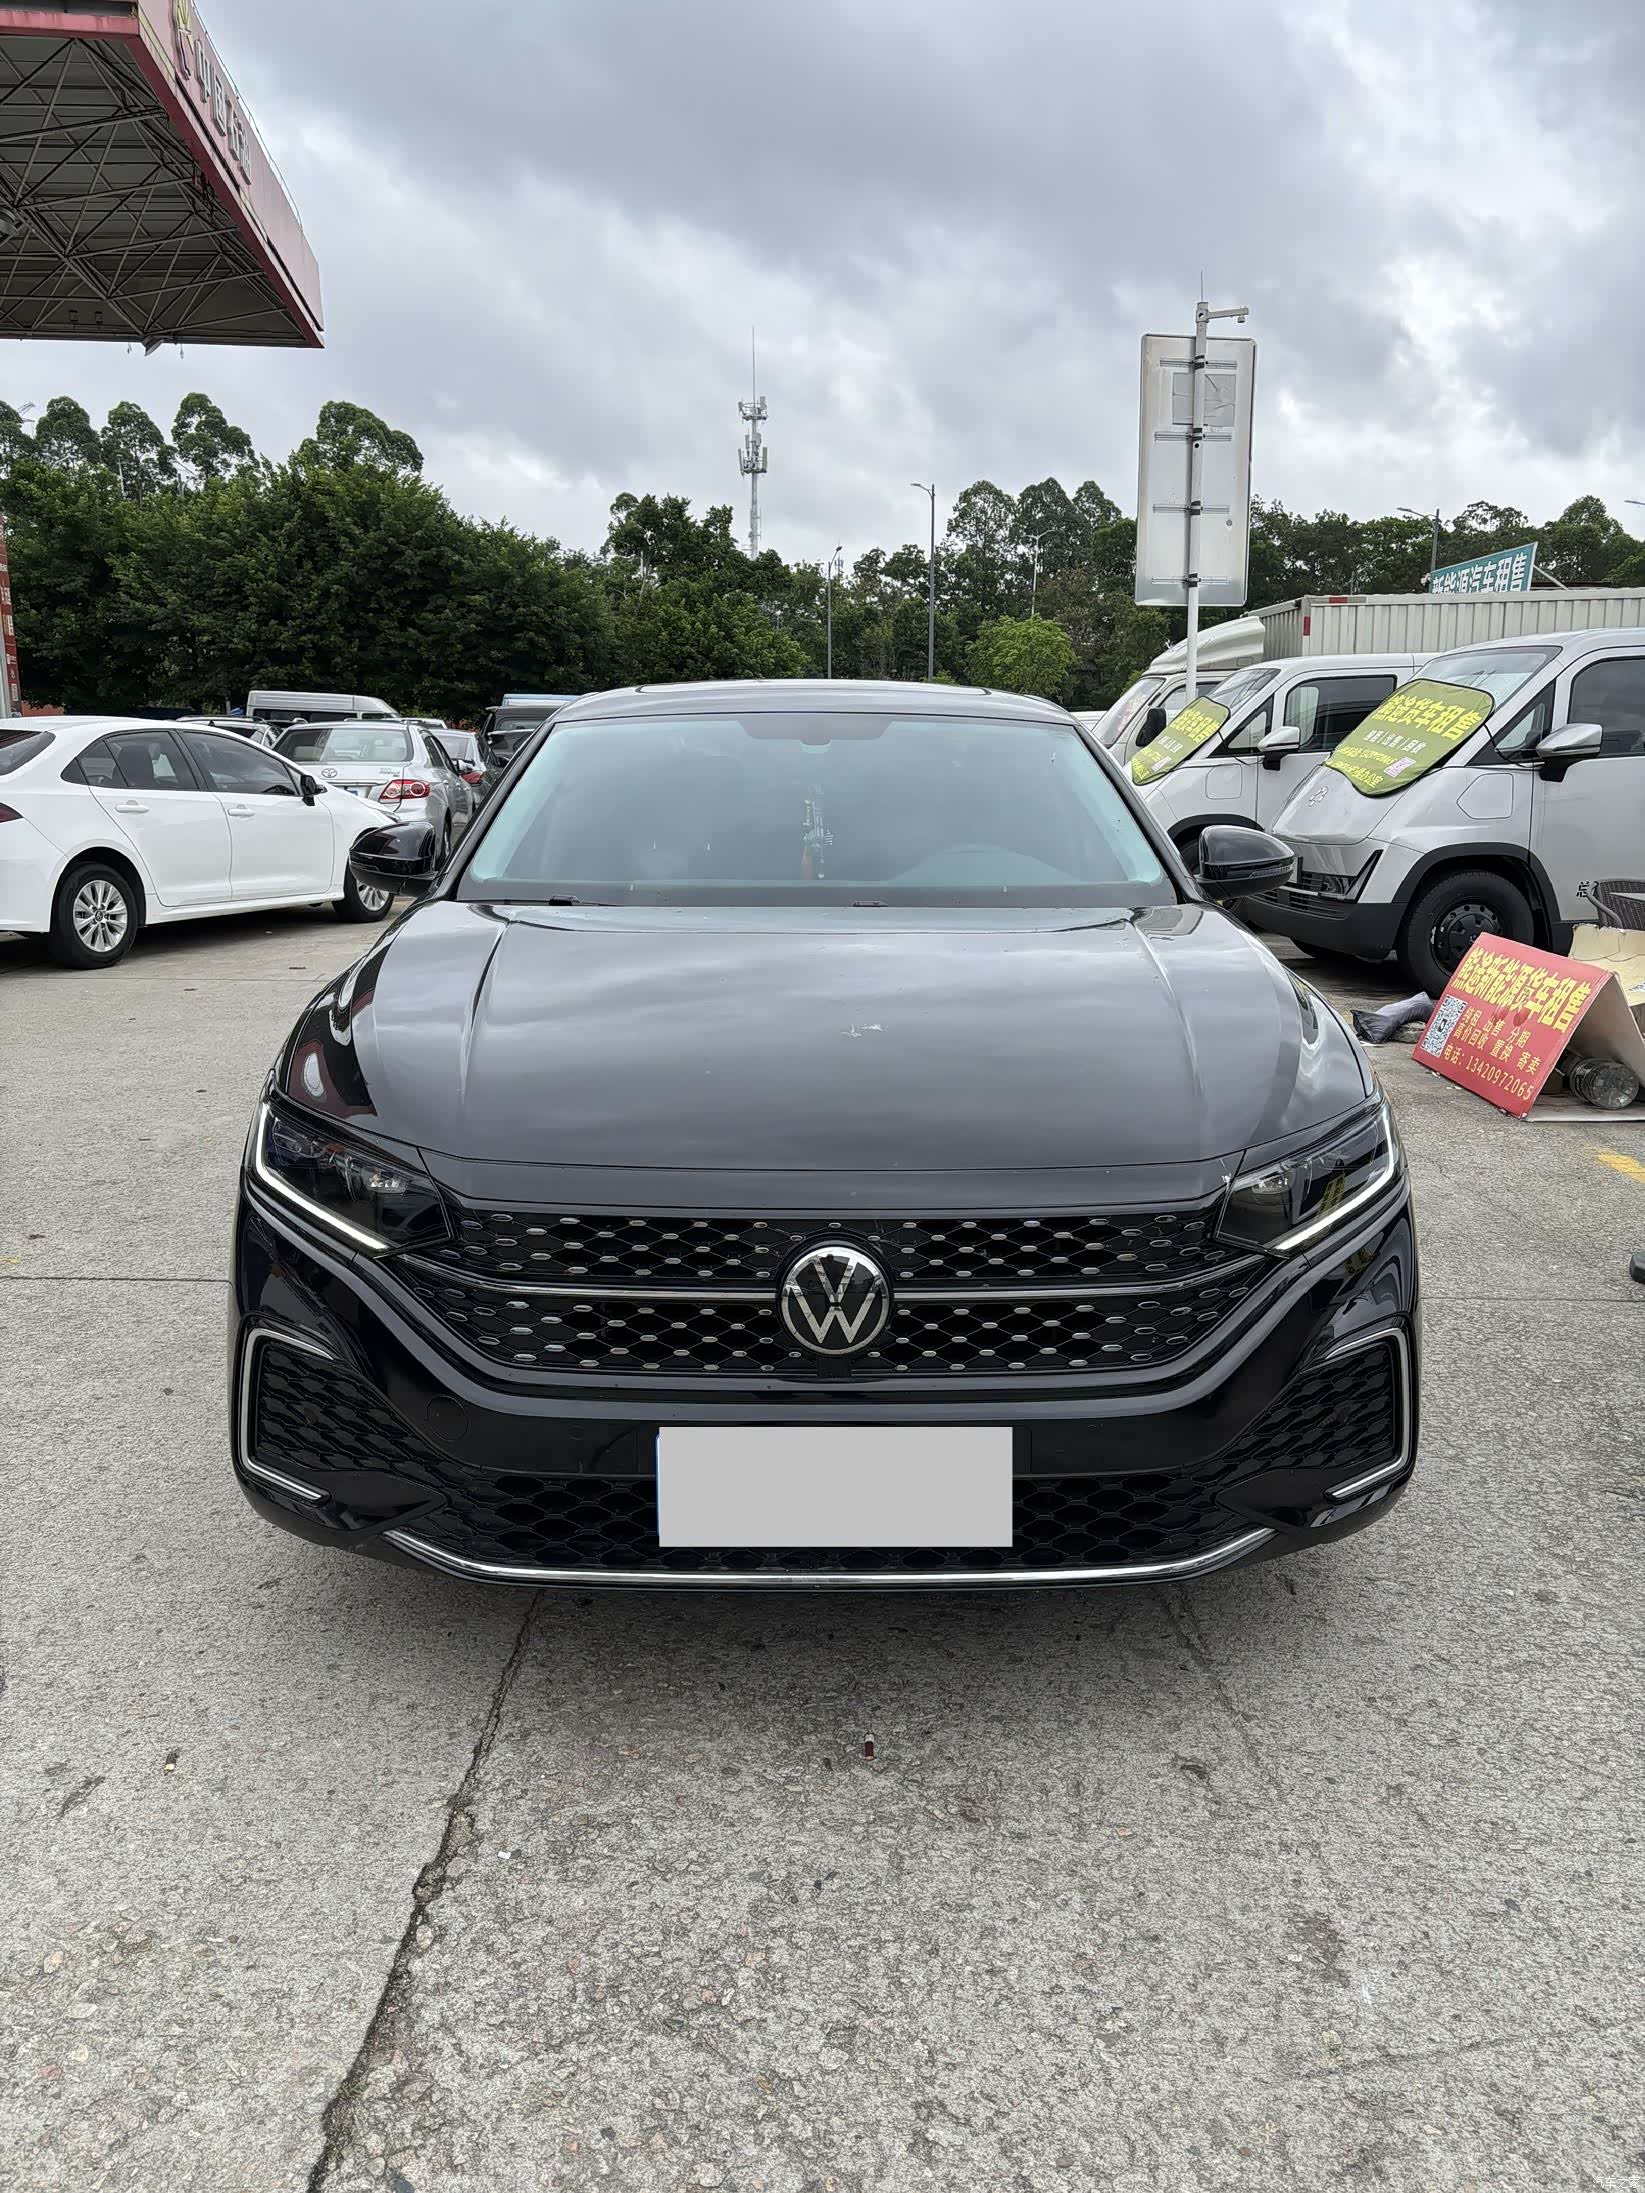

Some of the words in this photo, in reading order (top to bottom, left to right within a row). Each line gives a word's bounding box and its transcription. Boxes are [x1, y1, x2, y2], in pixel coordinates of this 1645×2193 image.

[1432, 552, 1528, 594] 新能源汽车租售
[1451, 946, 1593, 1033] 熊途新能源货车租售
[1453, 1025, 1489, 1051] 高价回收
[1489, 1039, 1515, 1063] 置换
[1517, 1052, 1541, 1076] 寄卖
[1507, 1023, 1532, 1048] 分期
